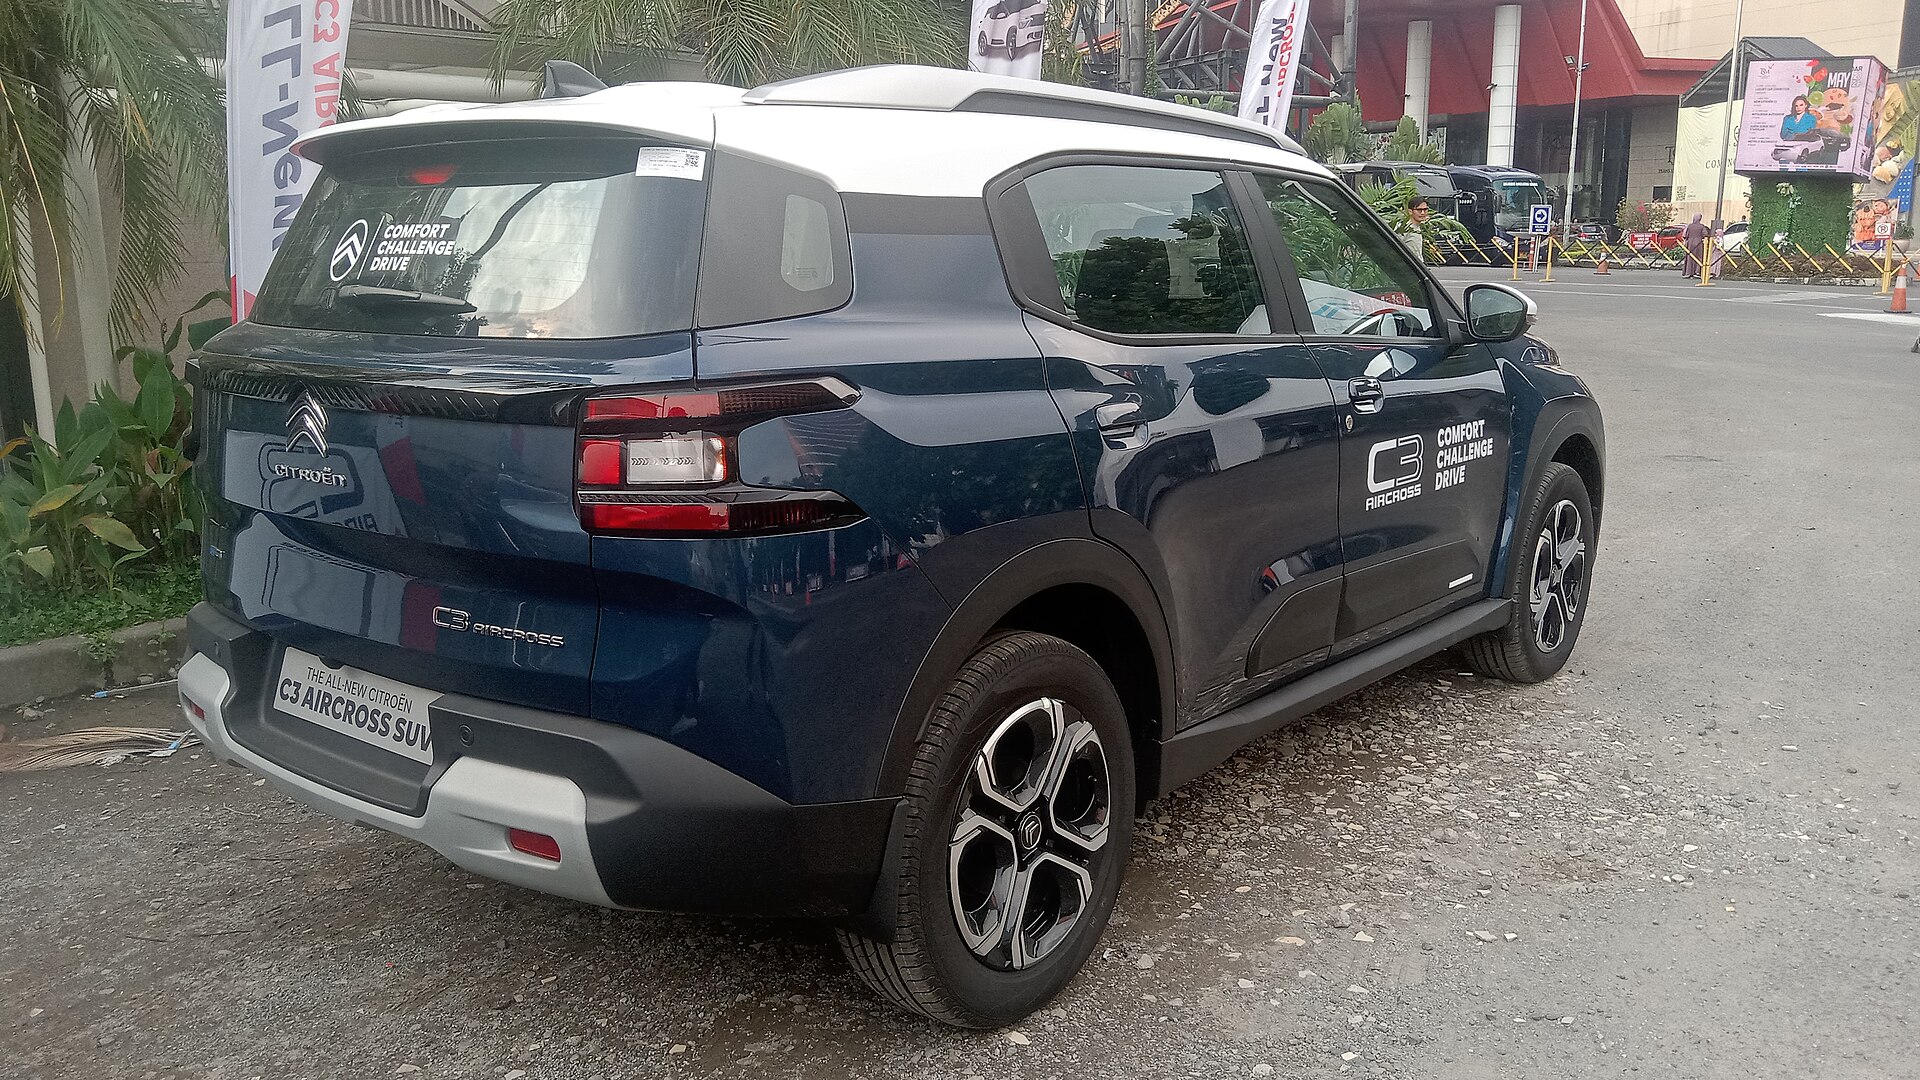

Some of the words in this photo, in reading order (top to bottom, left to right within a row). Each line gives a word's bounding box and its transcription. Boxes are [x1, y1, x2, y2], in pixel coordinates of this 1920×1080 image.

[1827, 72, 1852, 88] MAY
[383, 223, 451, 239] COMFORT
[377, 240, 456, 256] CHALLENGE
[369, 256, 411, 271] DRIVE
[1437, 419, 1486, 448] COMFORT
[1367, 433, 1424, 493] C3
[1435, 437, 1494, 469] CHALLENGE
[274, 463, 348, 488] CITROËN
[1434, 464, 1467, 491] DRIVE
[1365, 483, 1422, 512] AIRCROSS
[432, 605, 471, 632] C3
[472, 622, 565, 648] AIRCROSS
[307, 666, 326, 685] THE
[325, 673, 368, 699] ALL-NEW
[368, 686, 413, 714] CITROËN
[279, 678, 302, 704] C3
[300, 686, 393, 738] AIRCROSS
